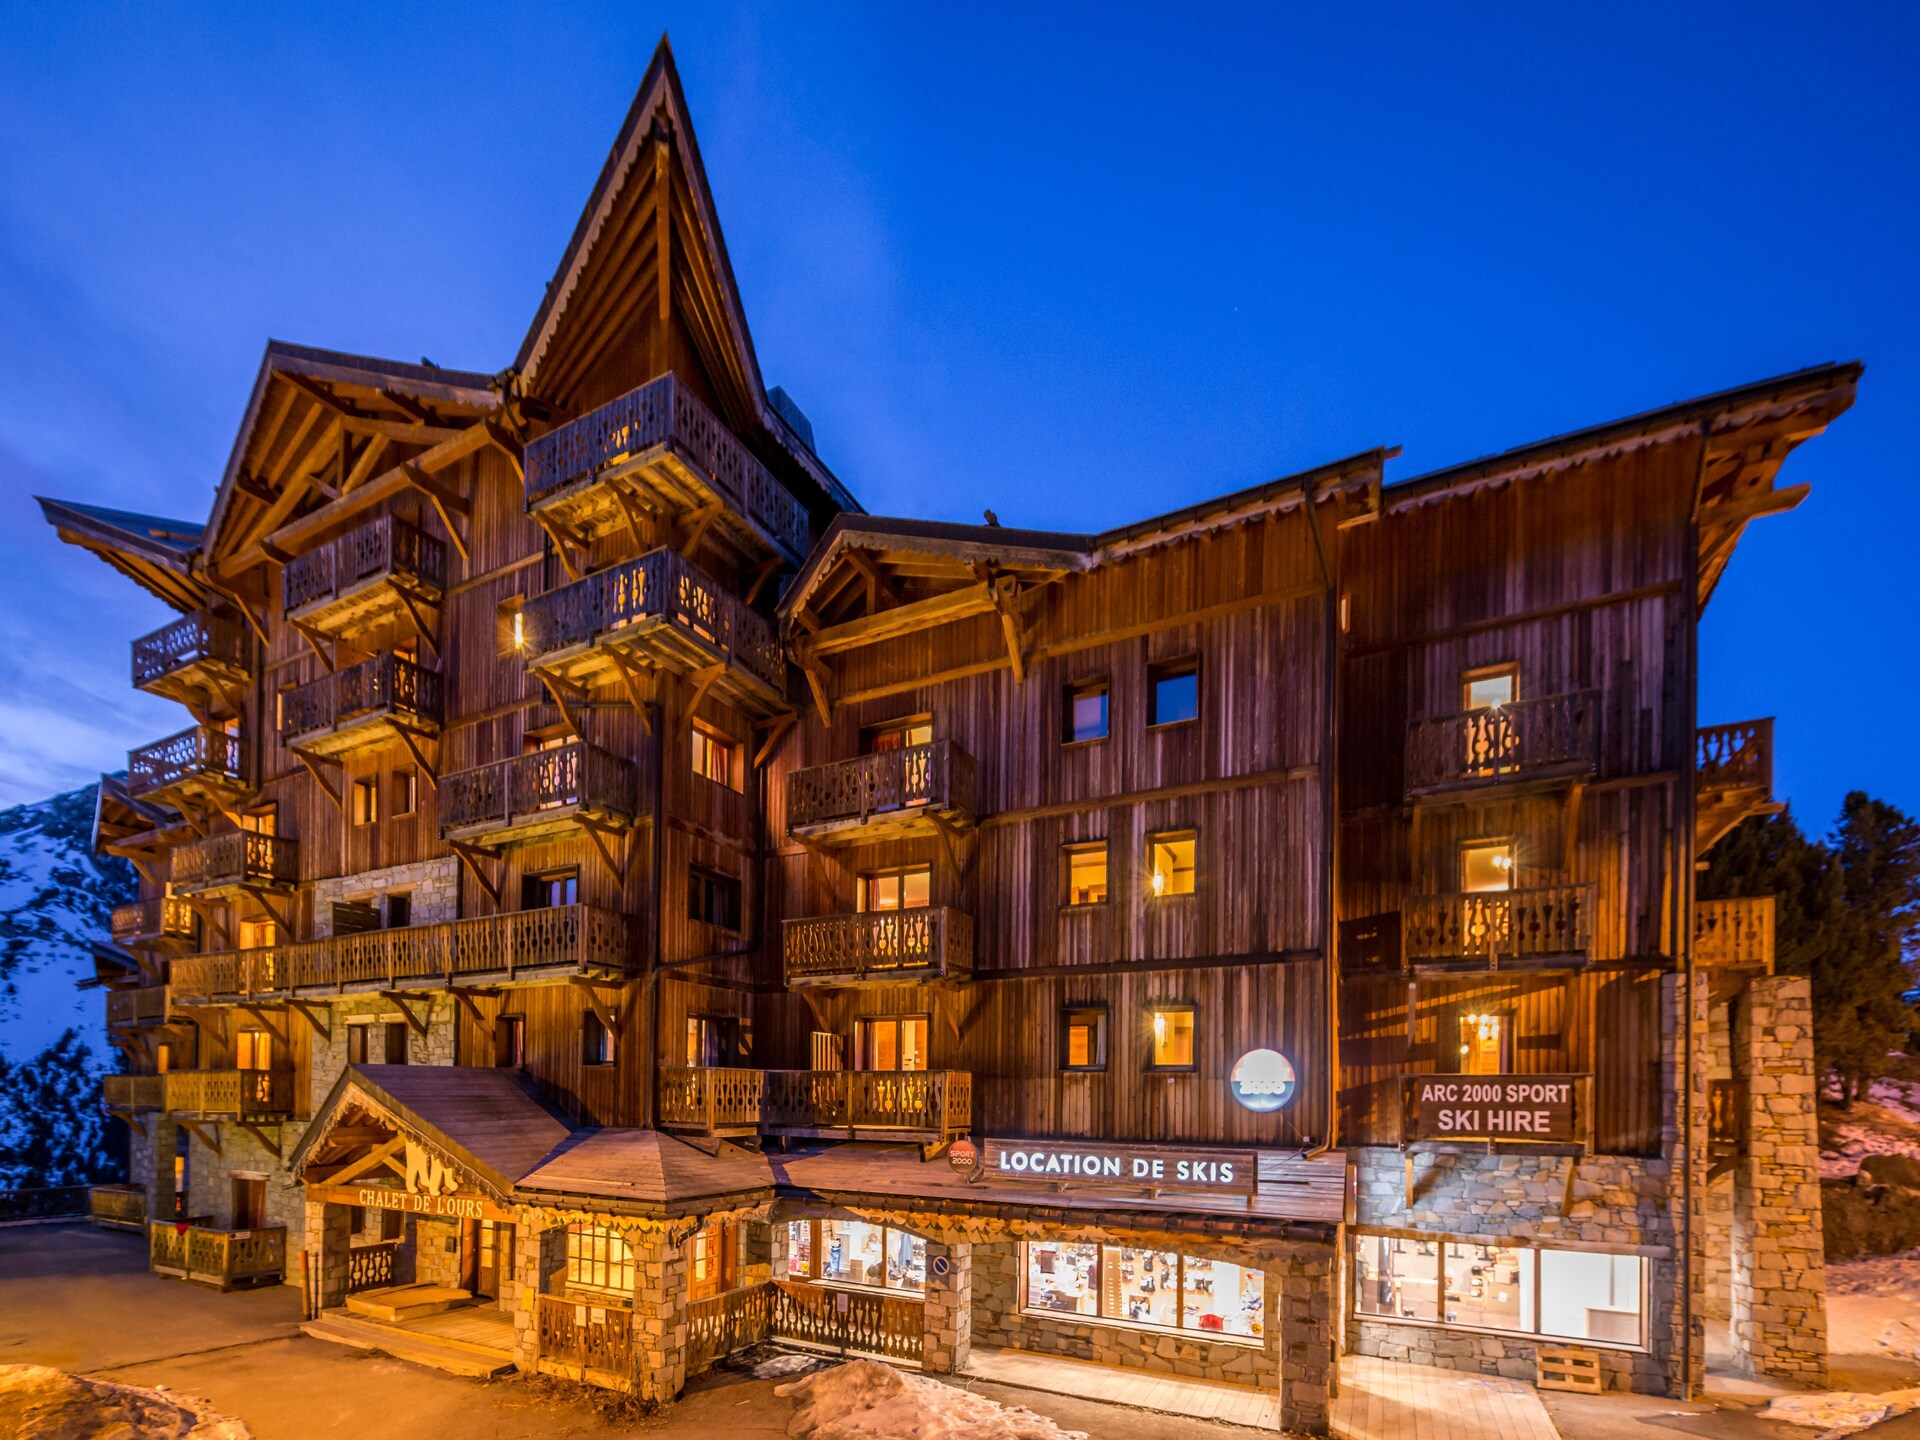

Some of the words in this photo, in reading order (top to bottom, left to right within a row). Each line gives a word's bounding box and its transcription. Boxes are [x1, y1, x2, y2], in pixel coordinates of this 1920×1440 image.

[1421, 1084, 1458, 1102] ARC
[1462, 1084, 1502, 1103] 2000
[1506, 1084, 1570, 1103] SPORT
[1438, 1109, 1480, 1131] SKI
[1487, 1110, 1551, 1132] HIRE
[950, 1150, 975, 1158] SPORT
[952, 1157, 973, 1165] 2000
[1000, 1151, 1121, 1177] LOCATION
[1132, 1159, 1164, 1179] DE
[1176, 1161, 1234, 1183] SKIS
[359, 1189, 408, 1211] CHALET
[413, 1195, 431, 1213] DE
[437, 1198, 484, 1218] L'OURS
